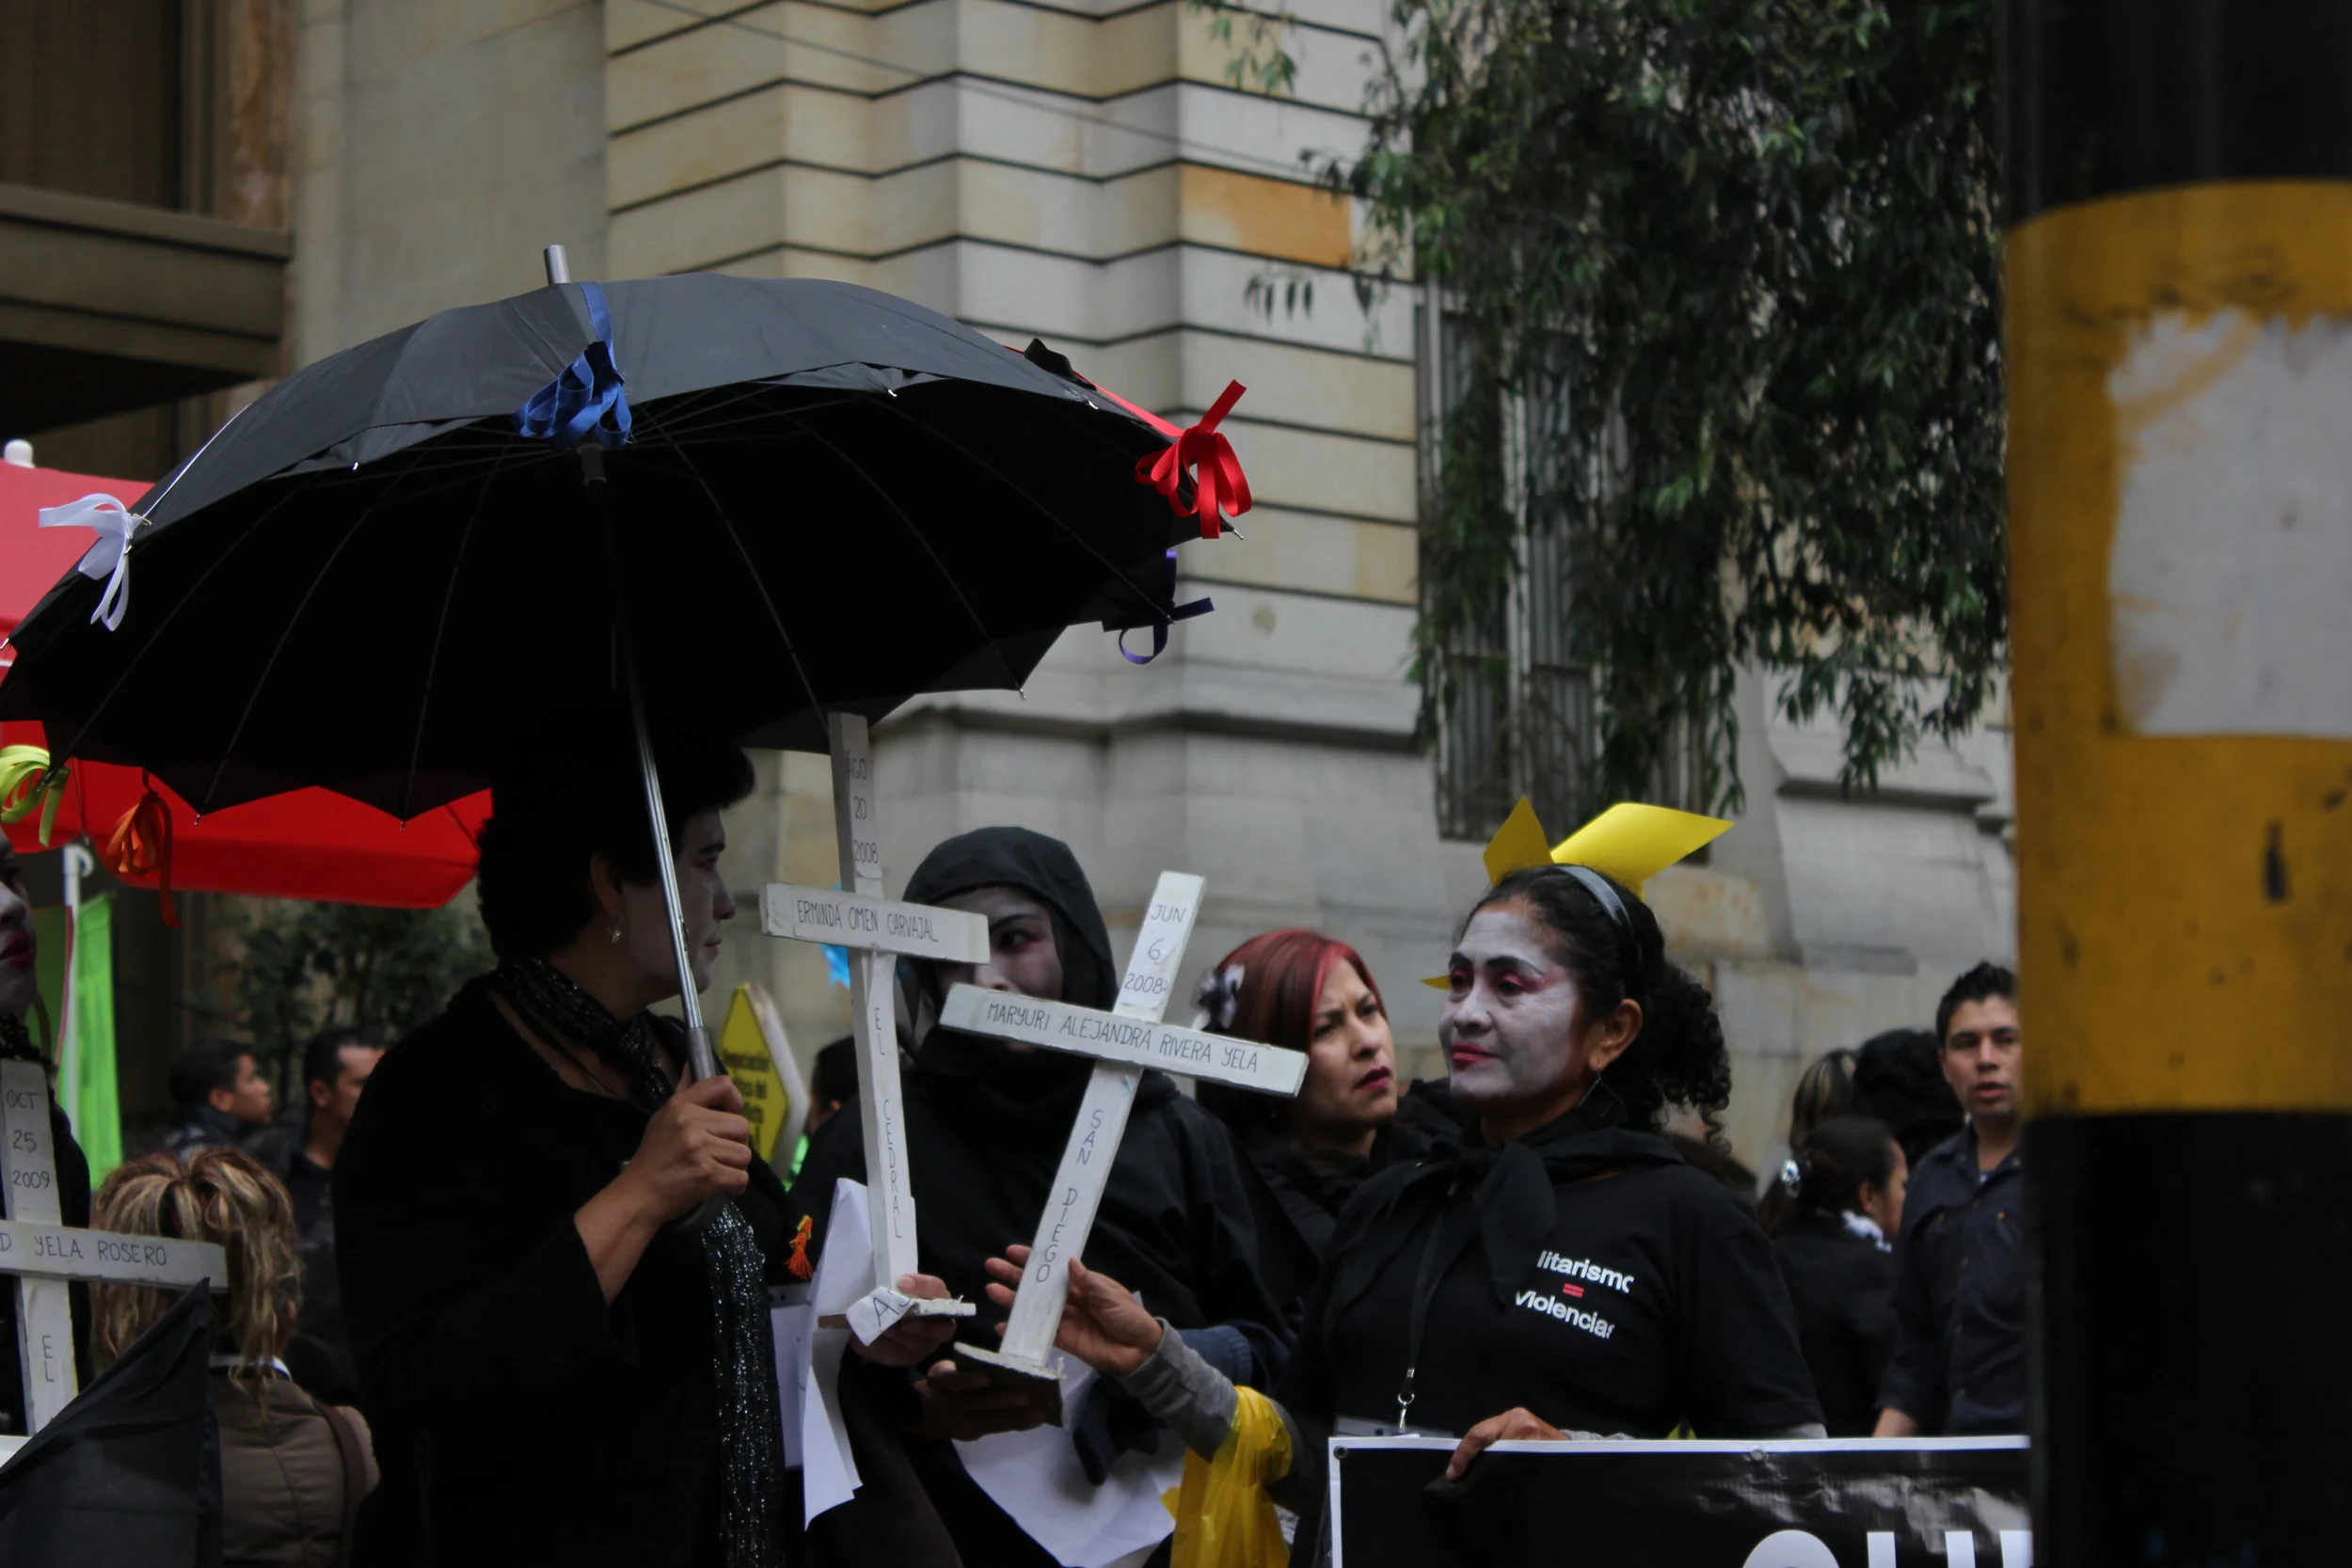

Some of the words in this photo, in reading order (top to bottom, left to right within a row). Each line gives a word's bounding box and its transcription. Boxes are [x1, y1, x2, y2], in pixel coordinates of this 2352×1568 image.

[853, 796, 867, 820] 20
[853, 840, 879, 864] 2008
[798, 900, 843, 930] ERMINDA
[849, 906, 878, 932] OMEN
[887, 912, 939, 942] CARVAJAL
[1150, 904, 1187, 924] JUN
[1147, 937, 1161, 961] 6
[1123, 973, 1164, 995] 2008
[987, 1003, 1051, 1031] MARYURI
[1059, 1015, 1152, 1052] ALEJANDRA
[1159, 1034, 1211, 1063] RIVERA
[1220, 1045, 1258, 1073] YELA
[7, 1089, 38, 1110] OCT
[874, 1007, 885, 1056] EL
[882, 1099, 903, 1239] CEDRAL
[12, 1130, 37, 1152] 25
[1077, 1109, 1104, 1165] SAN
[12, 1170, 51, 1190] 2009
[1036, 1188, 1078, 1283] DIEGO
[34, 1234, 85, 1259] YELA
[98, 1240, 167, 1266] ROSERO
[41, 1335, 55, 1383] EL
